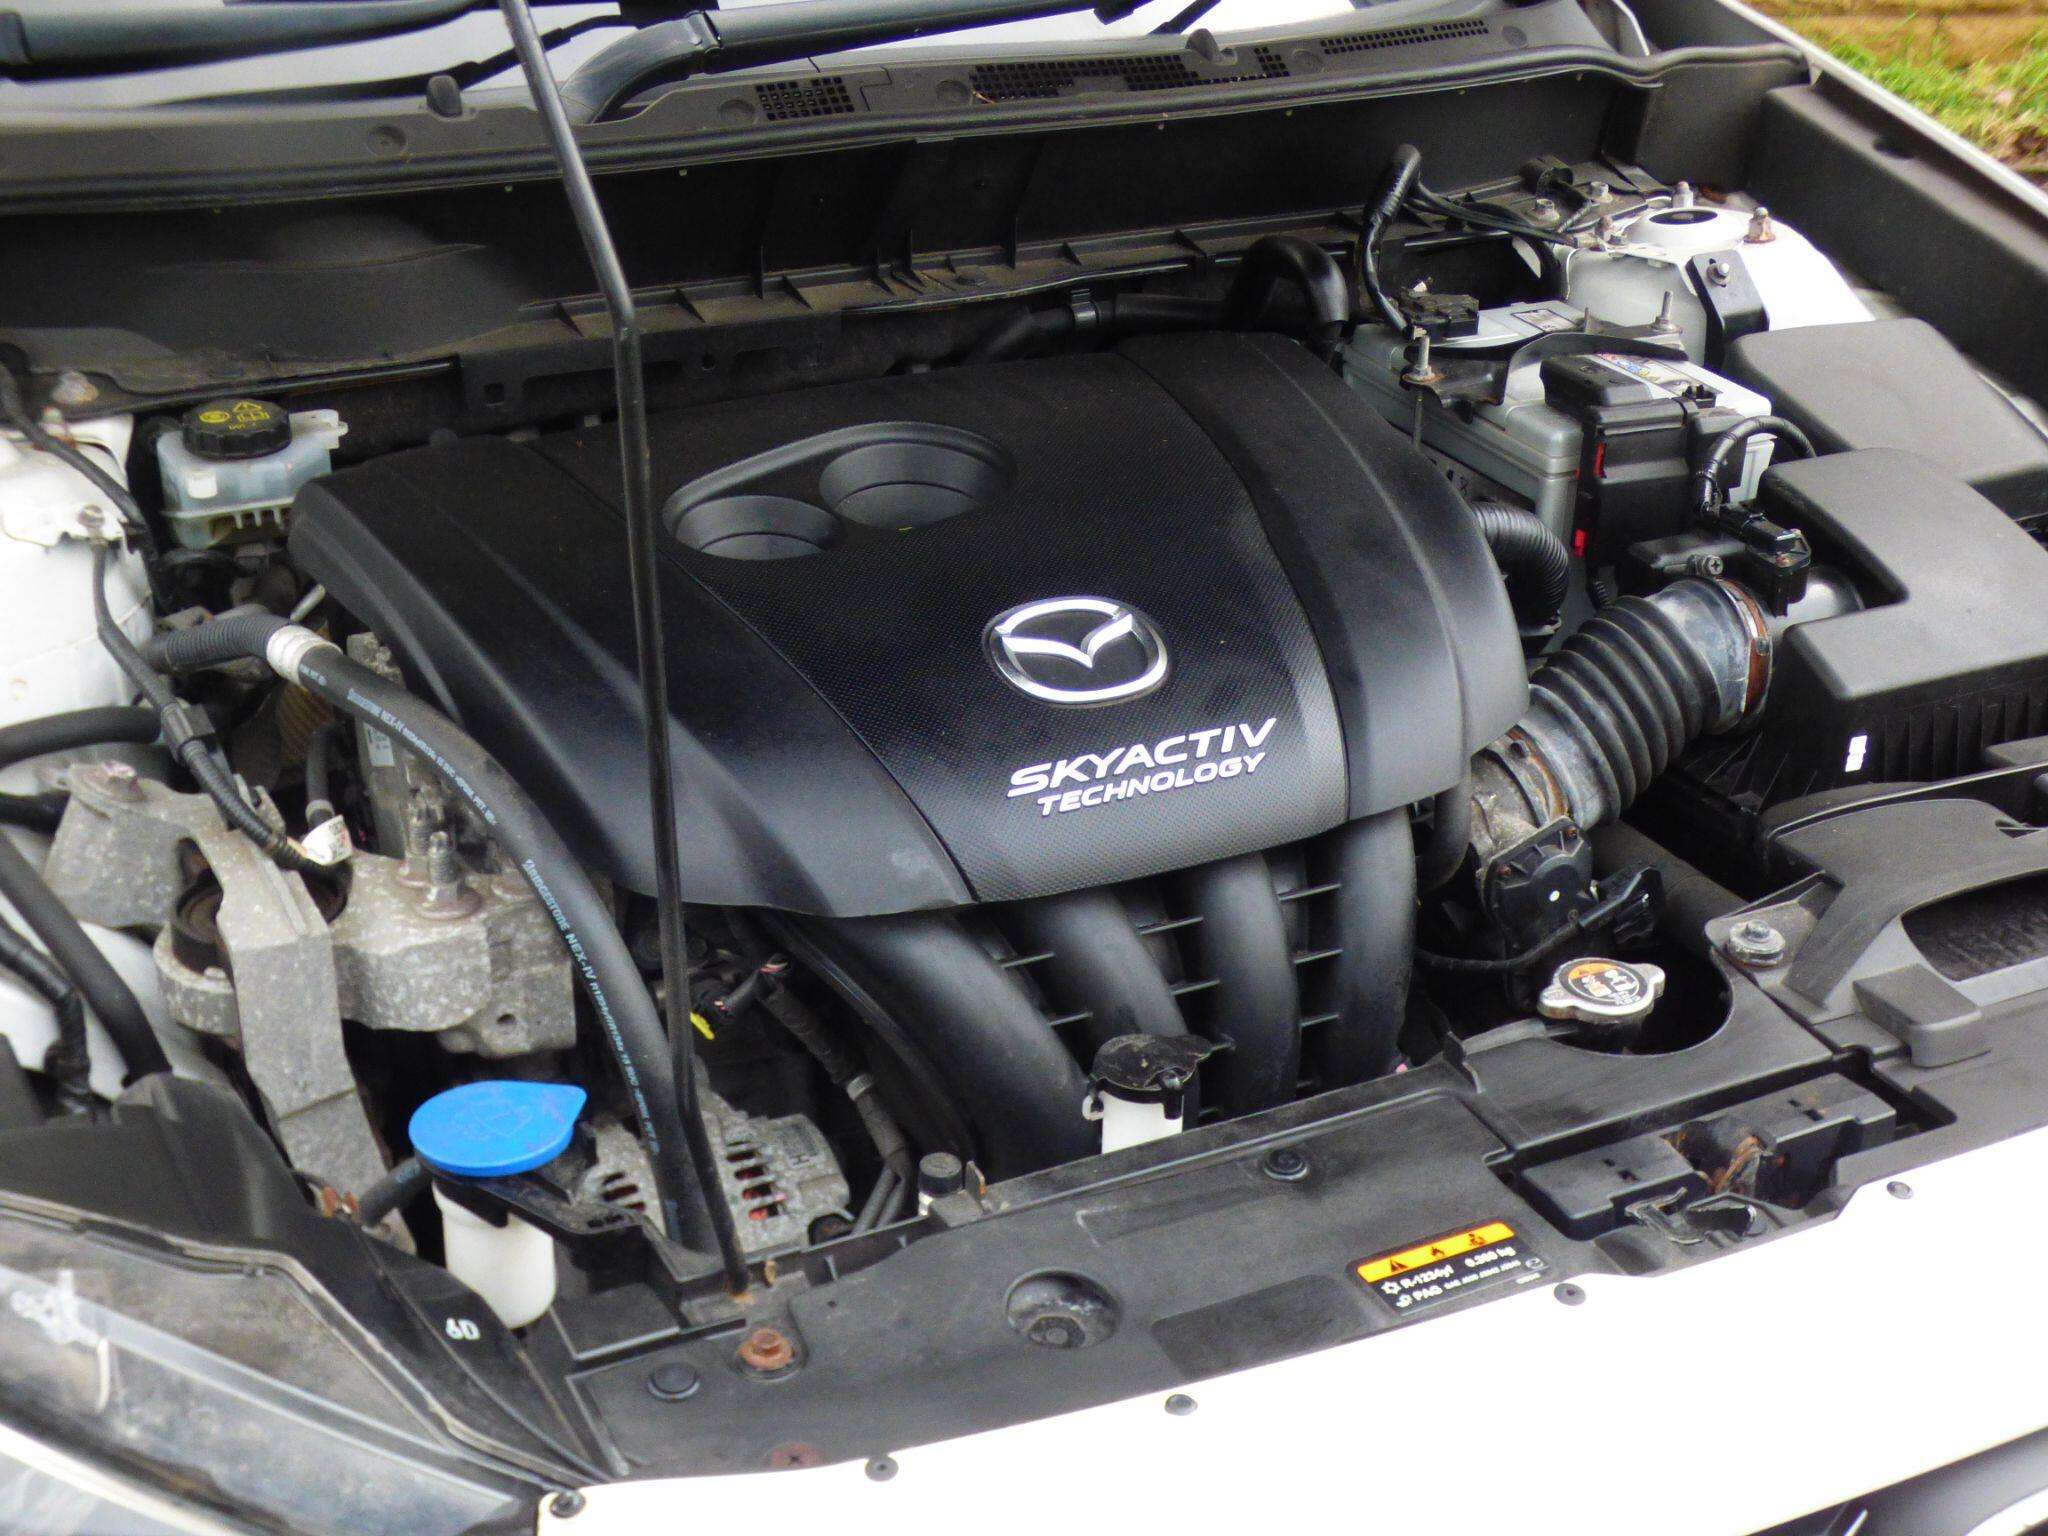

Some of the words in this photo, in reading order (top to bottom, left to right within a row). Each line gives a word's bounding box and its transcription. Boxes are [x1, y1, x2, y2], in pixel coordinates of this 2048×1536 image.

[1007, 717, 1277, 798] SKYACTIV
[1037, 752, 1266, 816] TECHNOLOGY
[565, 933, 597, 979] NEX-IV
[1412, 1285, 1443, 1301] PAG
